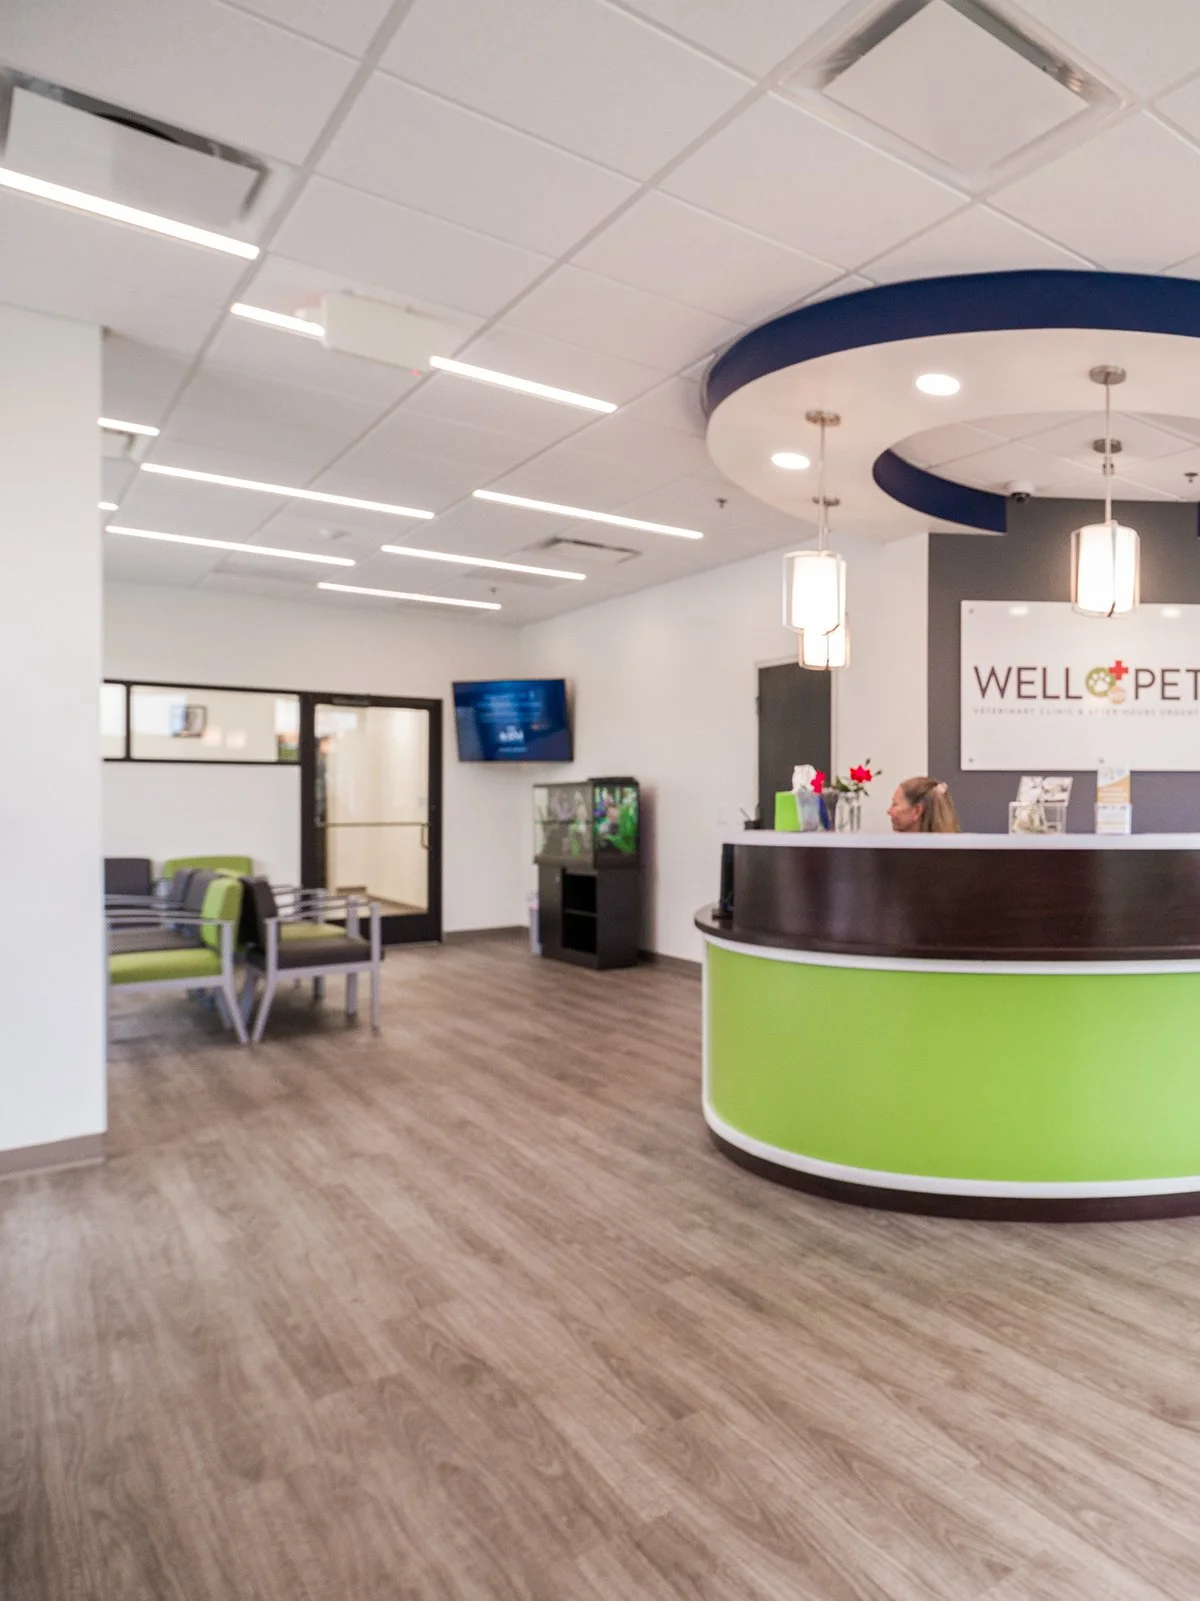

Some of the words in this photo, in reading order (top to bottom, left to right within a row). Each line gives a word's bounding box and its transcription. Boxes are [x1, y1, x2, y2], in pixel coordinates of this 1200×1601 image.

[973, 666, 1082, 699] WELL
[973, 707, 1036, 715] VETERINARY
[1039, 707, 1073, 716] CLINIC
